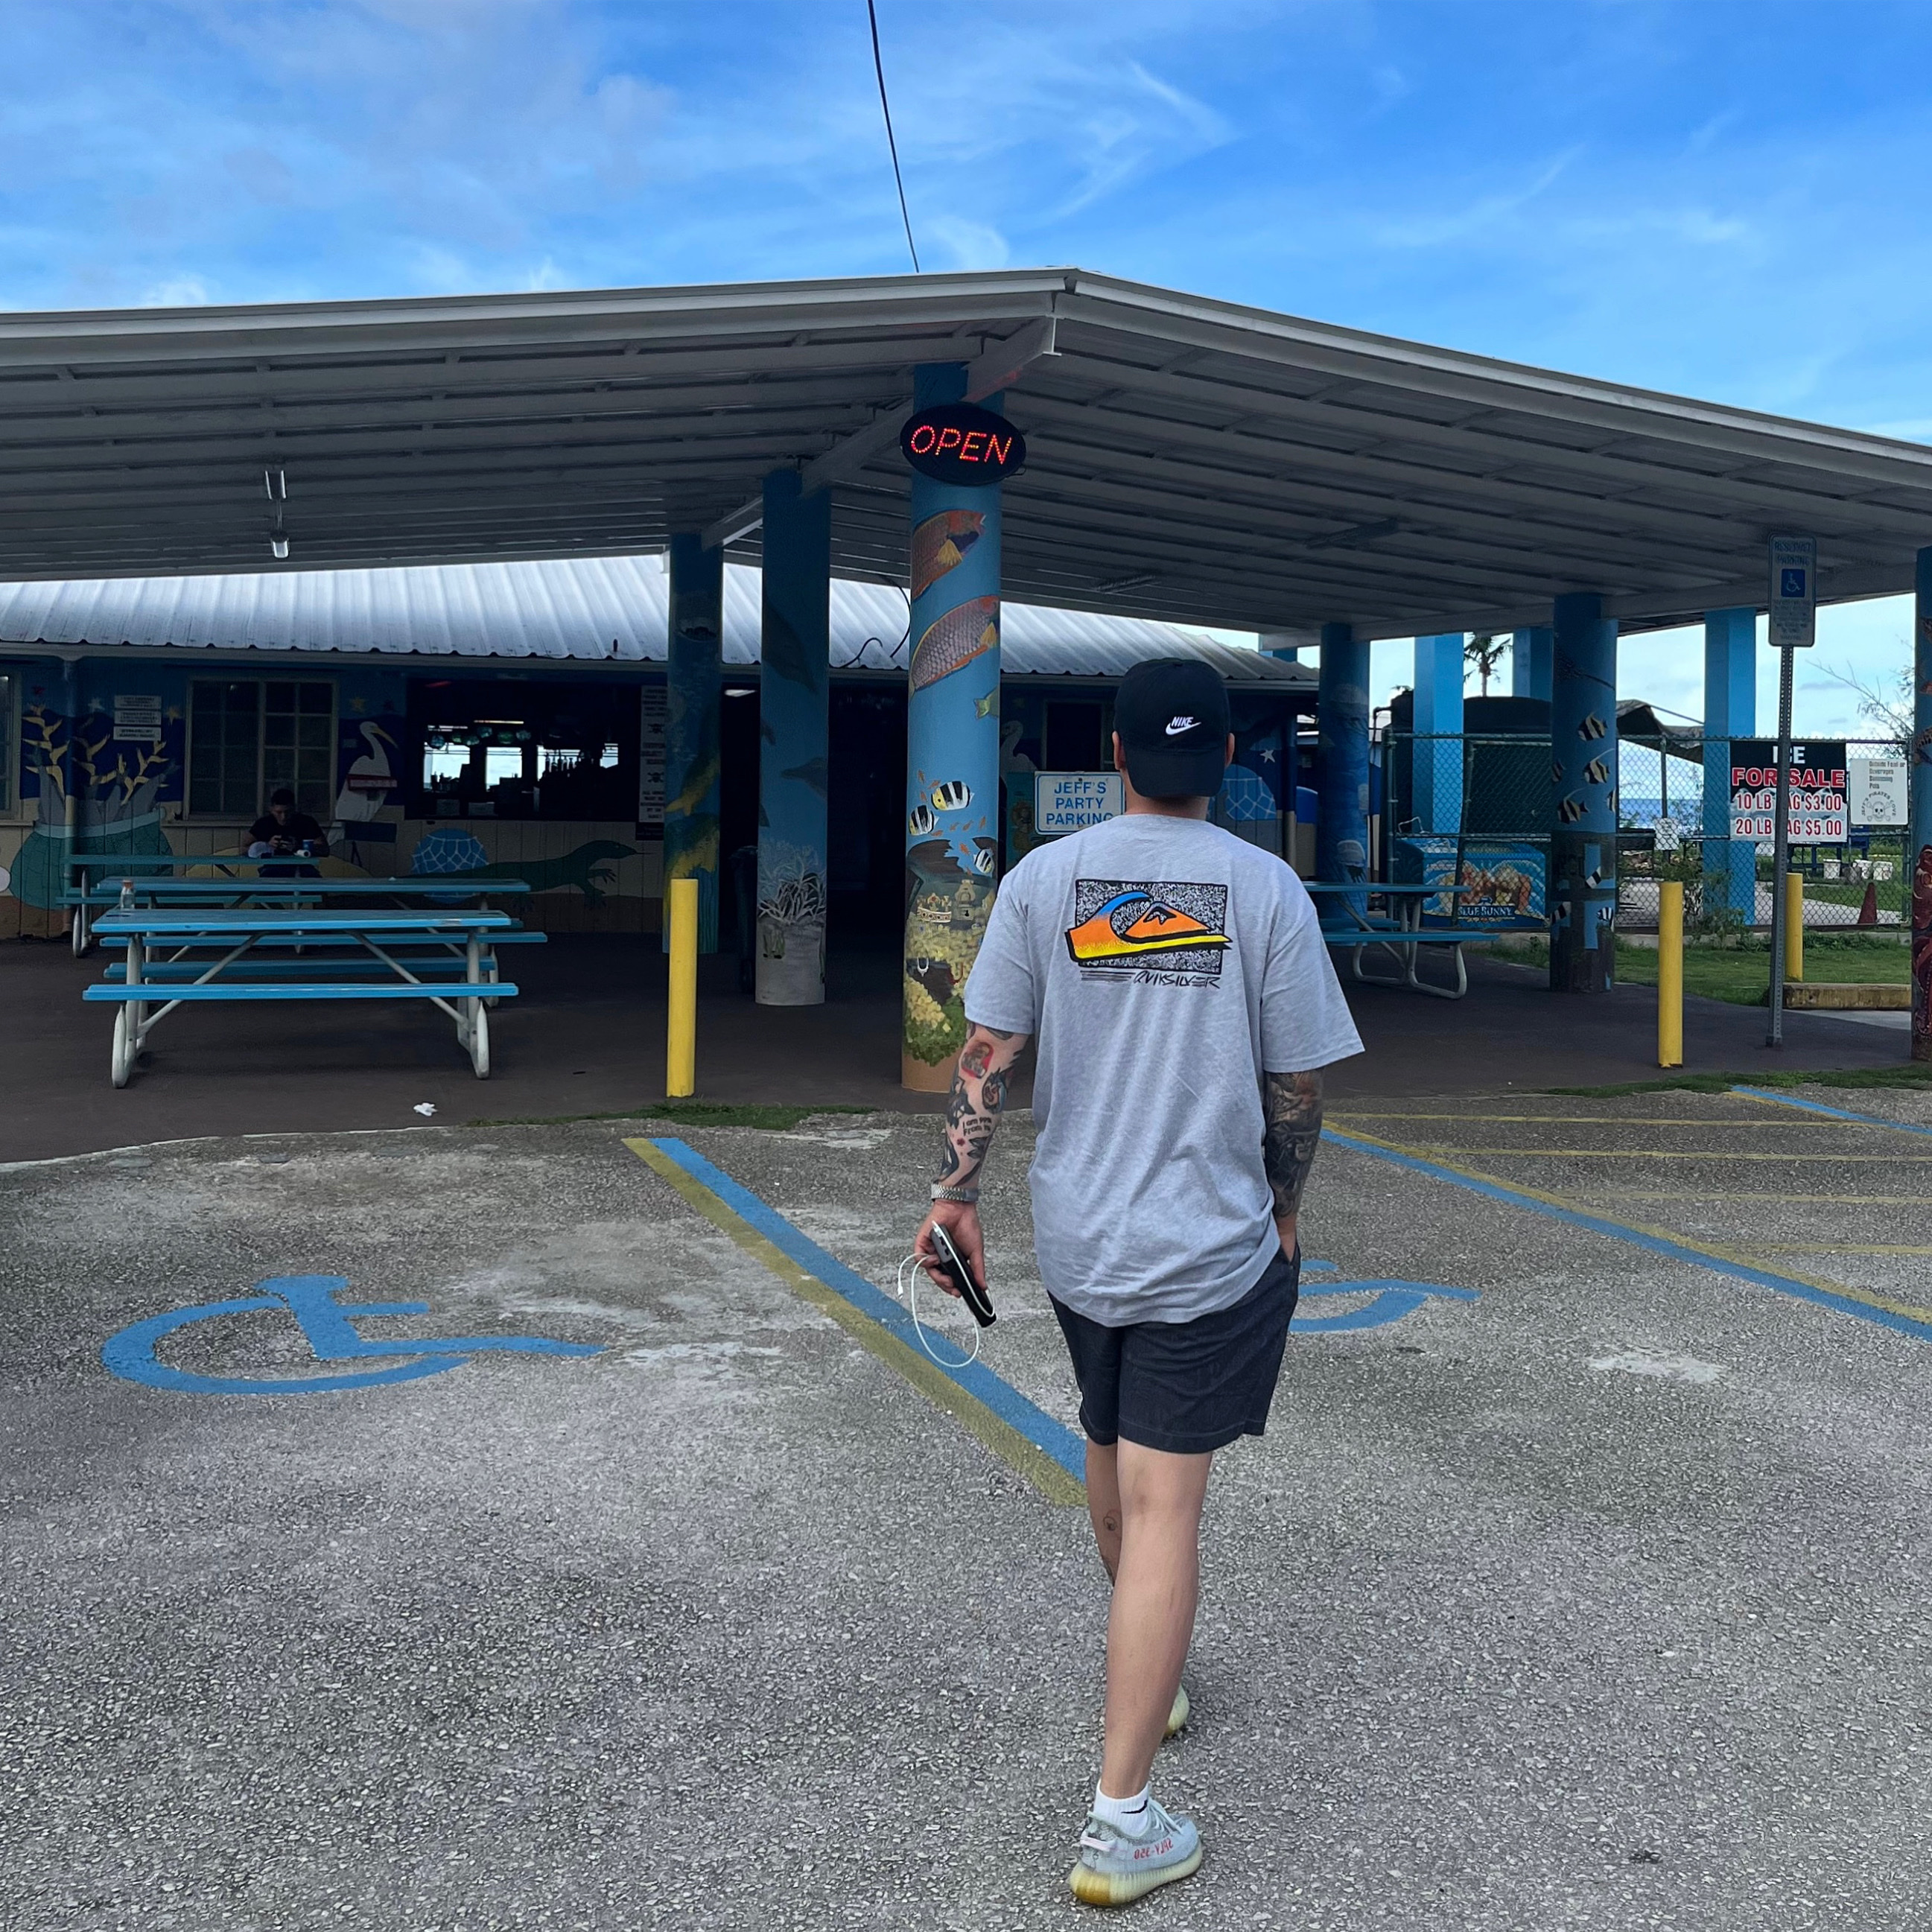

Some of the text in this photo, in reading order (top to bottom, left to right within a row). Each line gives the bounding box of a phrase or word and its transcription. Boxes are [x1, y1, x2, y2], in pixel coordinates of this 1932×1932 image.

[911, 425, 1012, 465] OPEN
[1172, 716, 1194, 727] NIKE
[1773, 746, 1805, 764] IE
[1732, 767, 1846, 788] FOR SALE
[1054, 781, 1107, 794] JEFF'S
[1869, 791, 1890, 799] PIRATES
[1055, 798, 1104, 809] PARTY
[1737, 794, 1752, 810] 10
[1756, 794, 1772, 810] LB
[1805, 794, 1842, 811] $3.00
[1736, 819, 1752, 834] 20
[1757, 819, 1772, 834] LB
[1805, 819, 1842, 836] $5.00
[1481, 905, 1513, 916] BUNNY
